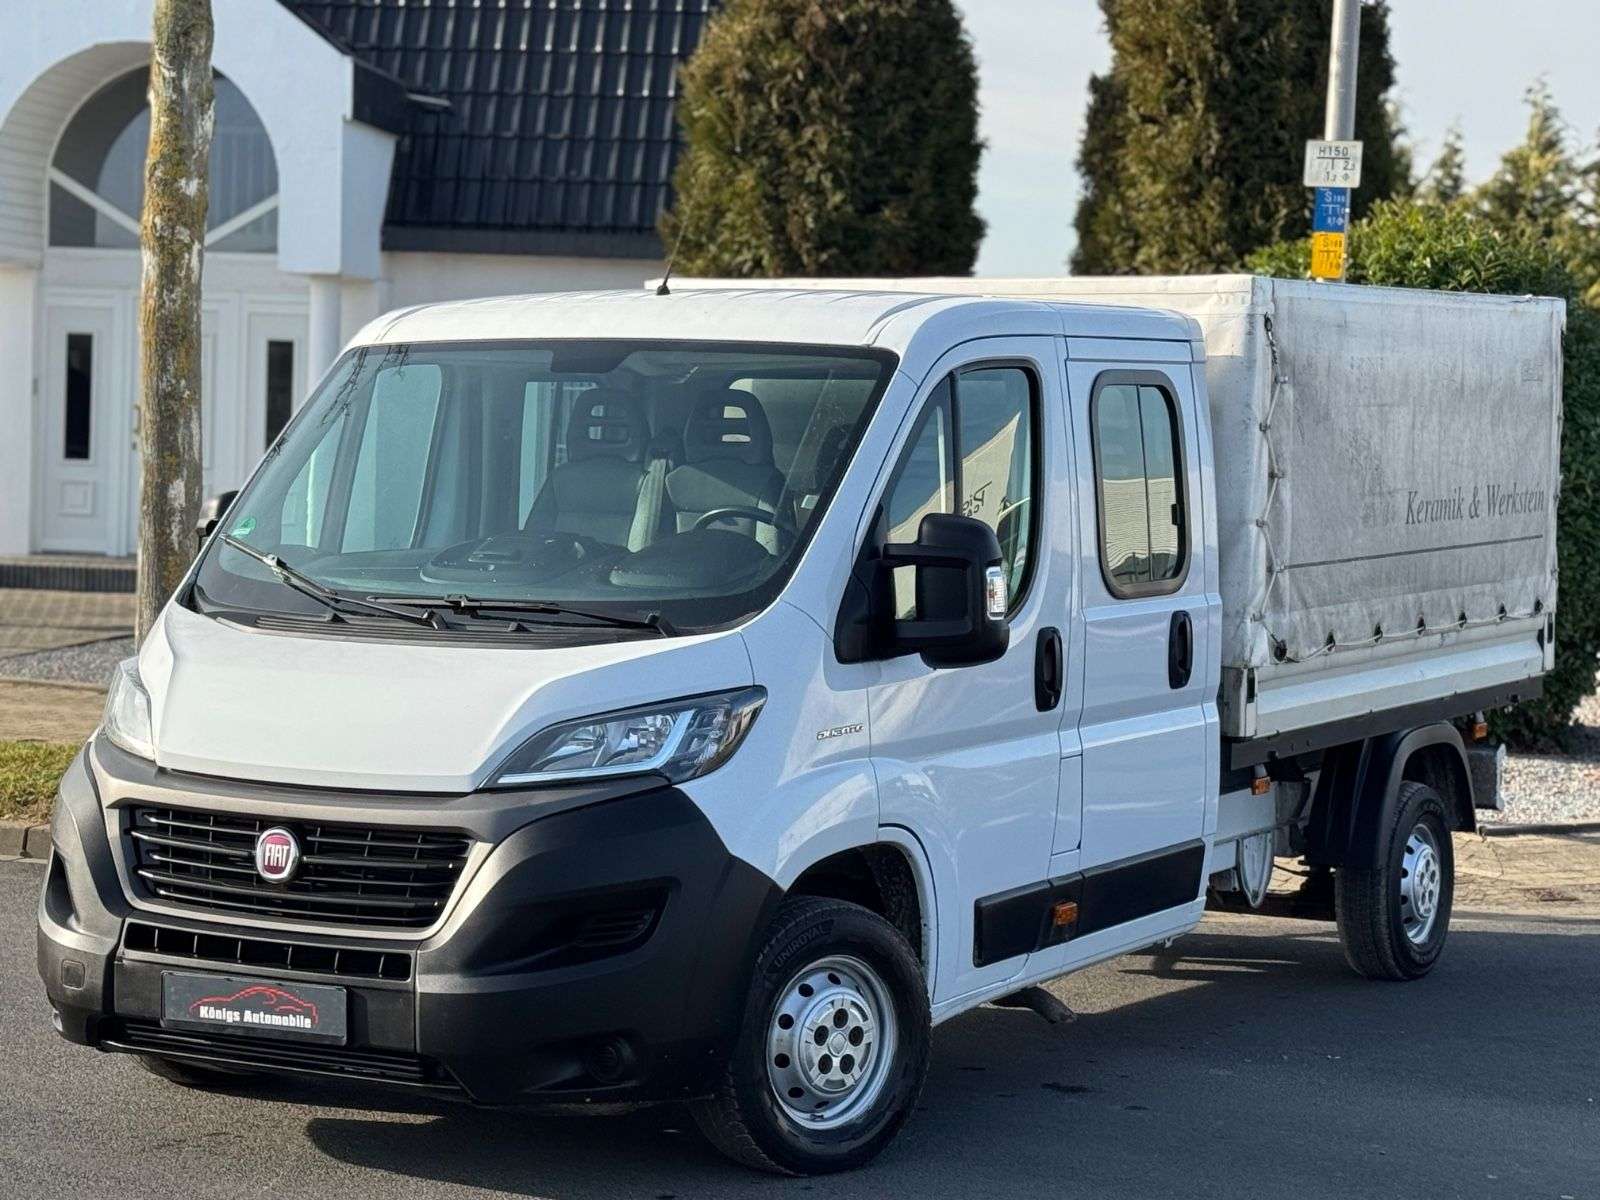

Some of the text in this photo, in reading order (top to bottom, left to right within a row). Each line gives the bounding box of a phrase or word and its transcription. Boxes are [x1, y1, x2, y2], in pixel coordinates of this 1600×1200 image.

[1318, 146, 1349, 156] H150
[1406, 482, 1545, 524] Keramik & Werkstein
[264, 843, 290, 867] FIAT
[774, 924, 826, 967] UNIROYAL
[200, 1005, 312, 1029] Königs Automobile
